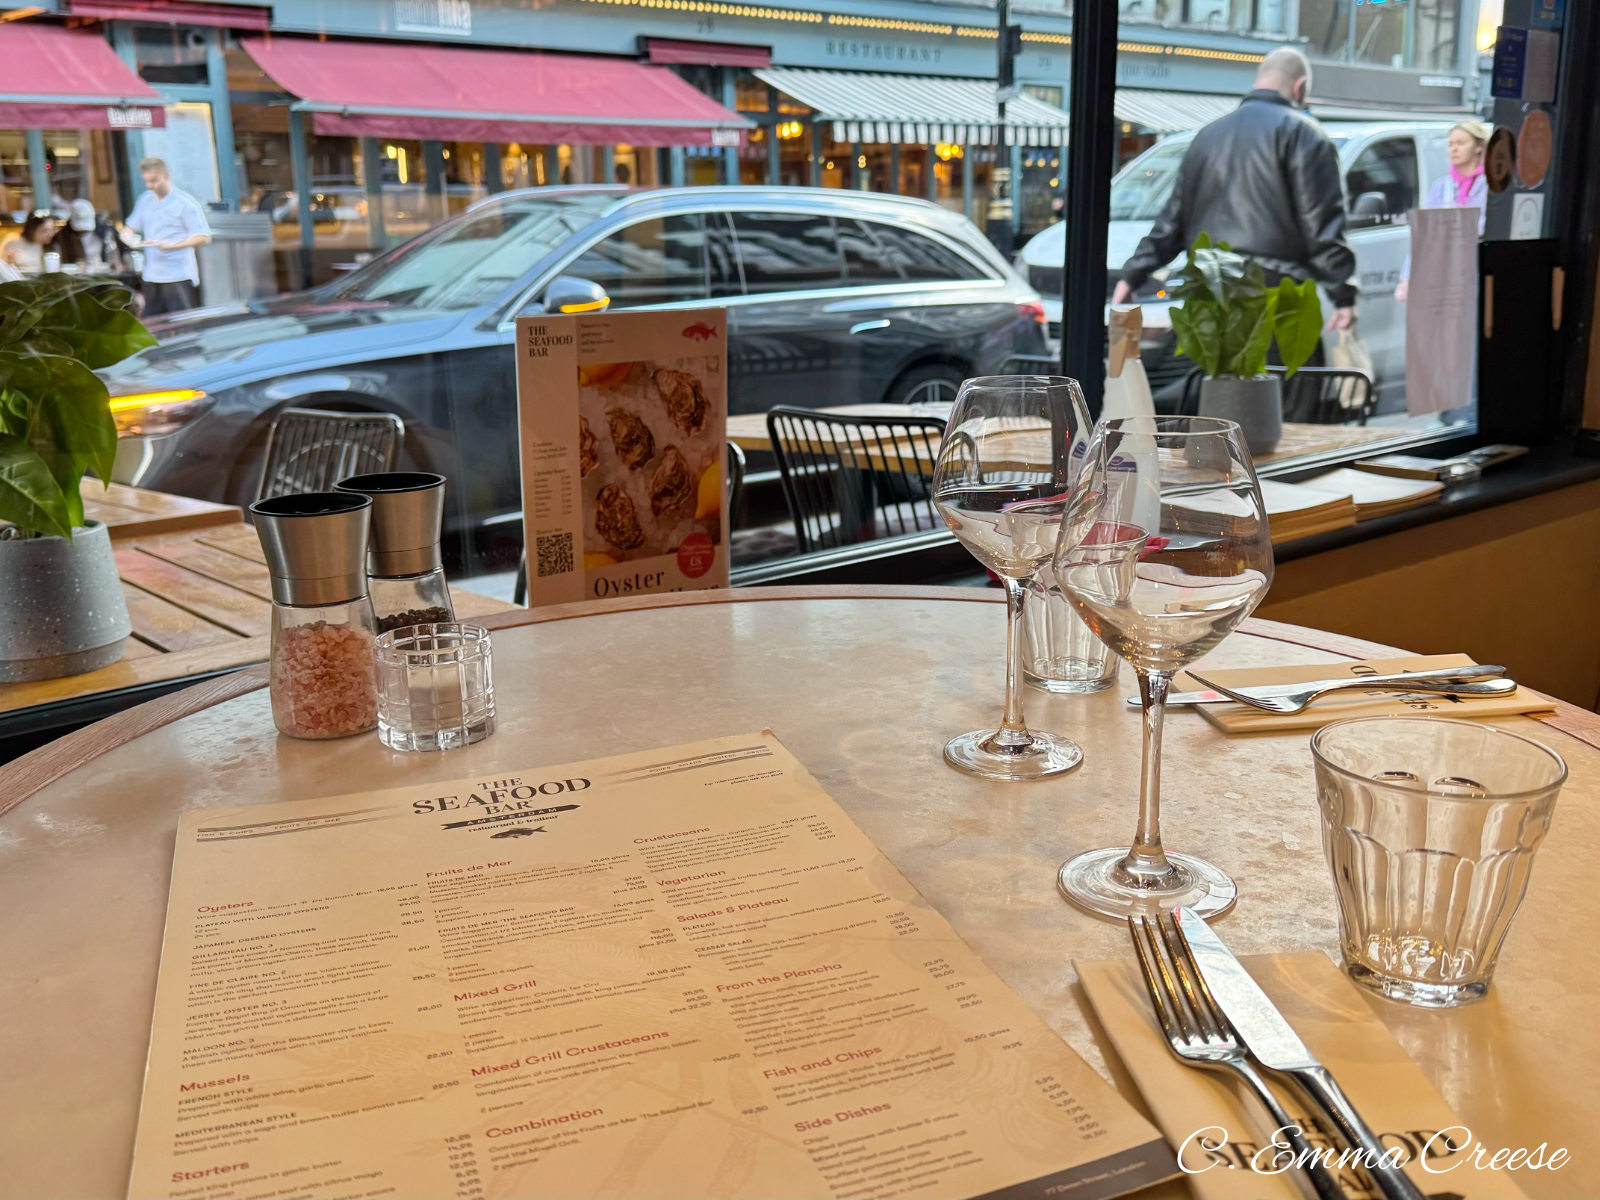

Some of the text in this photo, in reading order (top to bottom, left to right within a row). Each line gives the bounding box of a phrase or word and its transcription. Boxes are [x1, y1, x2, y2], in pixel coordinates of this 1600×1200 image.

[826, 39, 942, 63] RESTAURANT
[528, 326, 548, 336] THE
[528, 336, 573, 347] SEAFOOD
[529, 347, 549, 358] BAR
[594, 571, 665, 599] Oyster
[476, 777, 523, 790] THE
[412, 777, 591, 814] SEAFOOD
[483, 799, 533, 815] BAR
[465, 807, 558, 825] AMSTERDAM
[468, 820, 515, 832] restaurant
[525, 814, 559, 823] traiteur
[633, 827, 710, 844] Crustaceans
[425, 868, 463, 878] Fruits
[486, 860, 512, 868] Mer
[655, 870, 726, 886] Vegetarian
[197, 901, 253, 913] Oysters
[676, 909, 723, 922] Salads
[737, 897, 789, 911] Plateau
[194, 920, 230, 928] PLATEAU
[256, 911, 292, 920] VARIOUS
[293, 905, 330, 914] OYSTERS
[437, 925, 466, 933] FRUITS
[519, 909, 558, 919] SEAFOOD
[889, 916, 910, 924] 20,50
[682, 921, 715, 931] PLATEAU
[898, 927, 919, 936] 22,50
[192, 927, 316, 950] JAPANESE DRESSED OYSTERS
[727, 938, 753, 946] SALAD
[670, 964, 691, 972] glass
[923, 958, 944, 967] 22,95
[928, 963, 950, 972] 25,75
[226, 974, 258, 983] CLAIRE
[715, 963, 842, 992] From the Plancha
[945, 981, 965, 990] 27,75
[453, 979, 537, 1002] Mixed Grill
[186, 1011, 221, 1021] JERSEY
[223, 1004, 259, 1014] OYSTER
[688, 1001, 711, 1010] 32,50
[468, 1029, 497, 1039] person
[471, 1035, 504, 1046] persons
[963, 1028, 1010, 1043] 10,50 glass
[182, 1043, 225, 1054] MALDON
[426, 1050, 453, 1060] 22,50
[470, 1031, 669, 1077] Mixed Grill Crustaceans
[712, 1052, 740, 1062] 149,00
[762, 1047, 882, 1079] Fish and Chips
[474, 1074, 531, 1088] Combination
[544, 1060, 596, 1074] crustaceans
[179, 1073, 250, 1092] Mussels
[432, 1080, 459, 1090] 22,50
[177, 1101, 220, 1113] Prepared
[245, 1093, 270, 1101] white
[298, 1083, 324, 1092] garlic
[346, 1074, 374, 1082] cream
[178, 1087, 253, 1105] FRENCH STYLE
[177, 1111, 209, 1121] Served
[234, 1103, 259, 1111] chips
[741, 1105, 768, 1114] 92,50
[794, 1103, 891, 1132] Side Dishes
[175, 1111, 296, 1138] MEDITERRANEAN STYLE
[485, 1108, 603, 1138] Combination
[171, 1161, 249, 1183] Starters
[449, 1159, 476, 1169] 12,50
[1113, 1161, 1146, 1176] London
